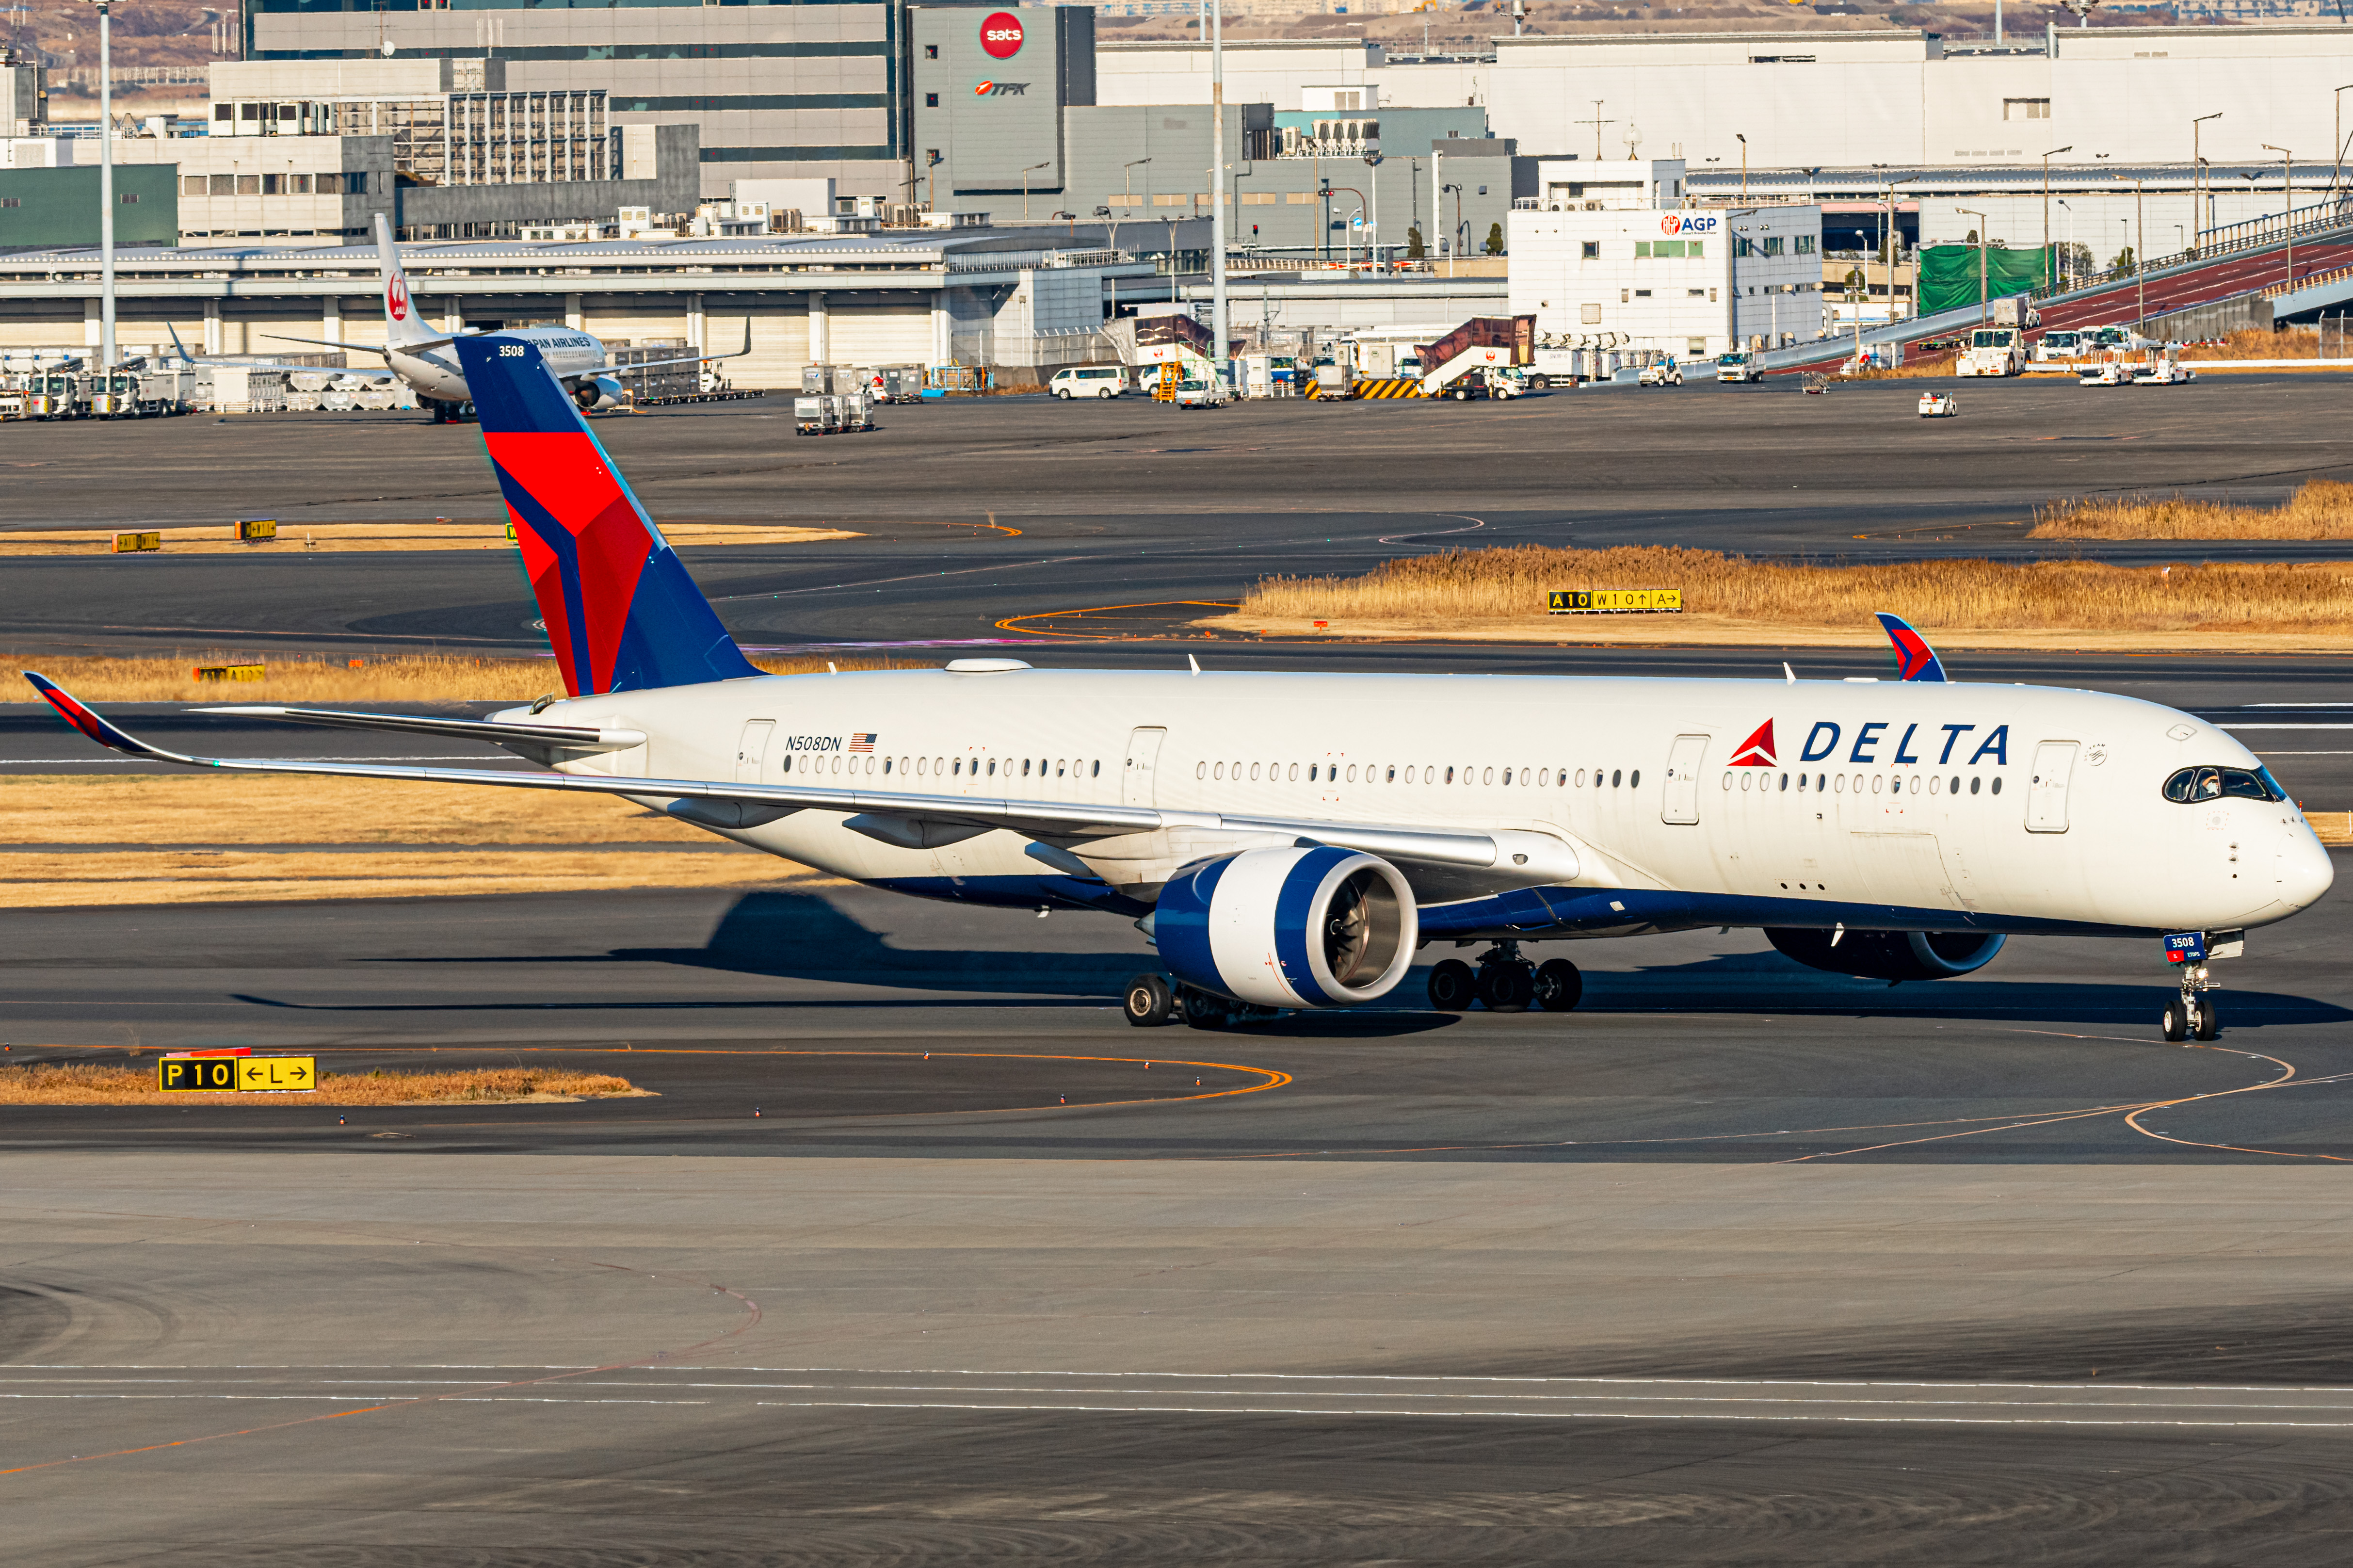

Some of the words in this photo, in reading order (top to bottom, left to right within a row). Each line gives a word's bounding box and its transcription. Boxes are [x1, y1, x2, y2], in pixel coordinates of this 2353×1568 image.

[987, 29, 1021, 41] sats
[991, 83, 1031, 96] TFK
[1681, 218, 1716, 231] AGP
[394, 306, 405, 315] JAL
[550, 337, 591, 348] AIRLINES
[499, 345, 524, 357] 3508
[1553, 594, 1588, 607] A10
[1597, 594, 1633, 605] W10
[1657, 594, 1666, 605] A
[786, 736, 842, 751] N508DN
[1800, 721, 2009, 765] DELTA
[2172, 937, 2194, 948] 3508
[168, 1064, 229, 1085] P10
[270, 1064, 283, 1083] L
